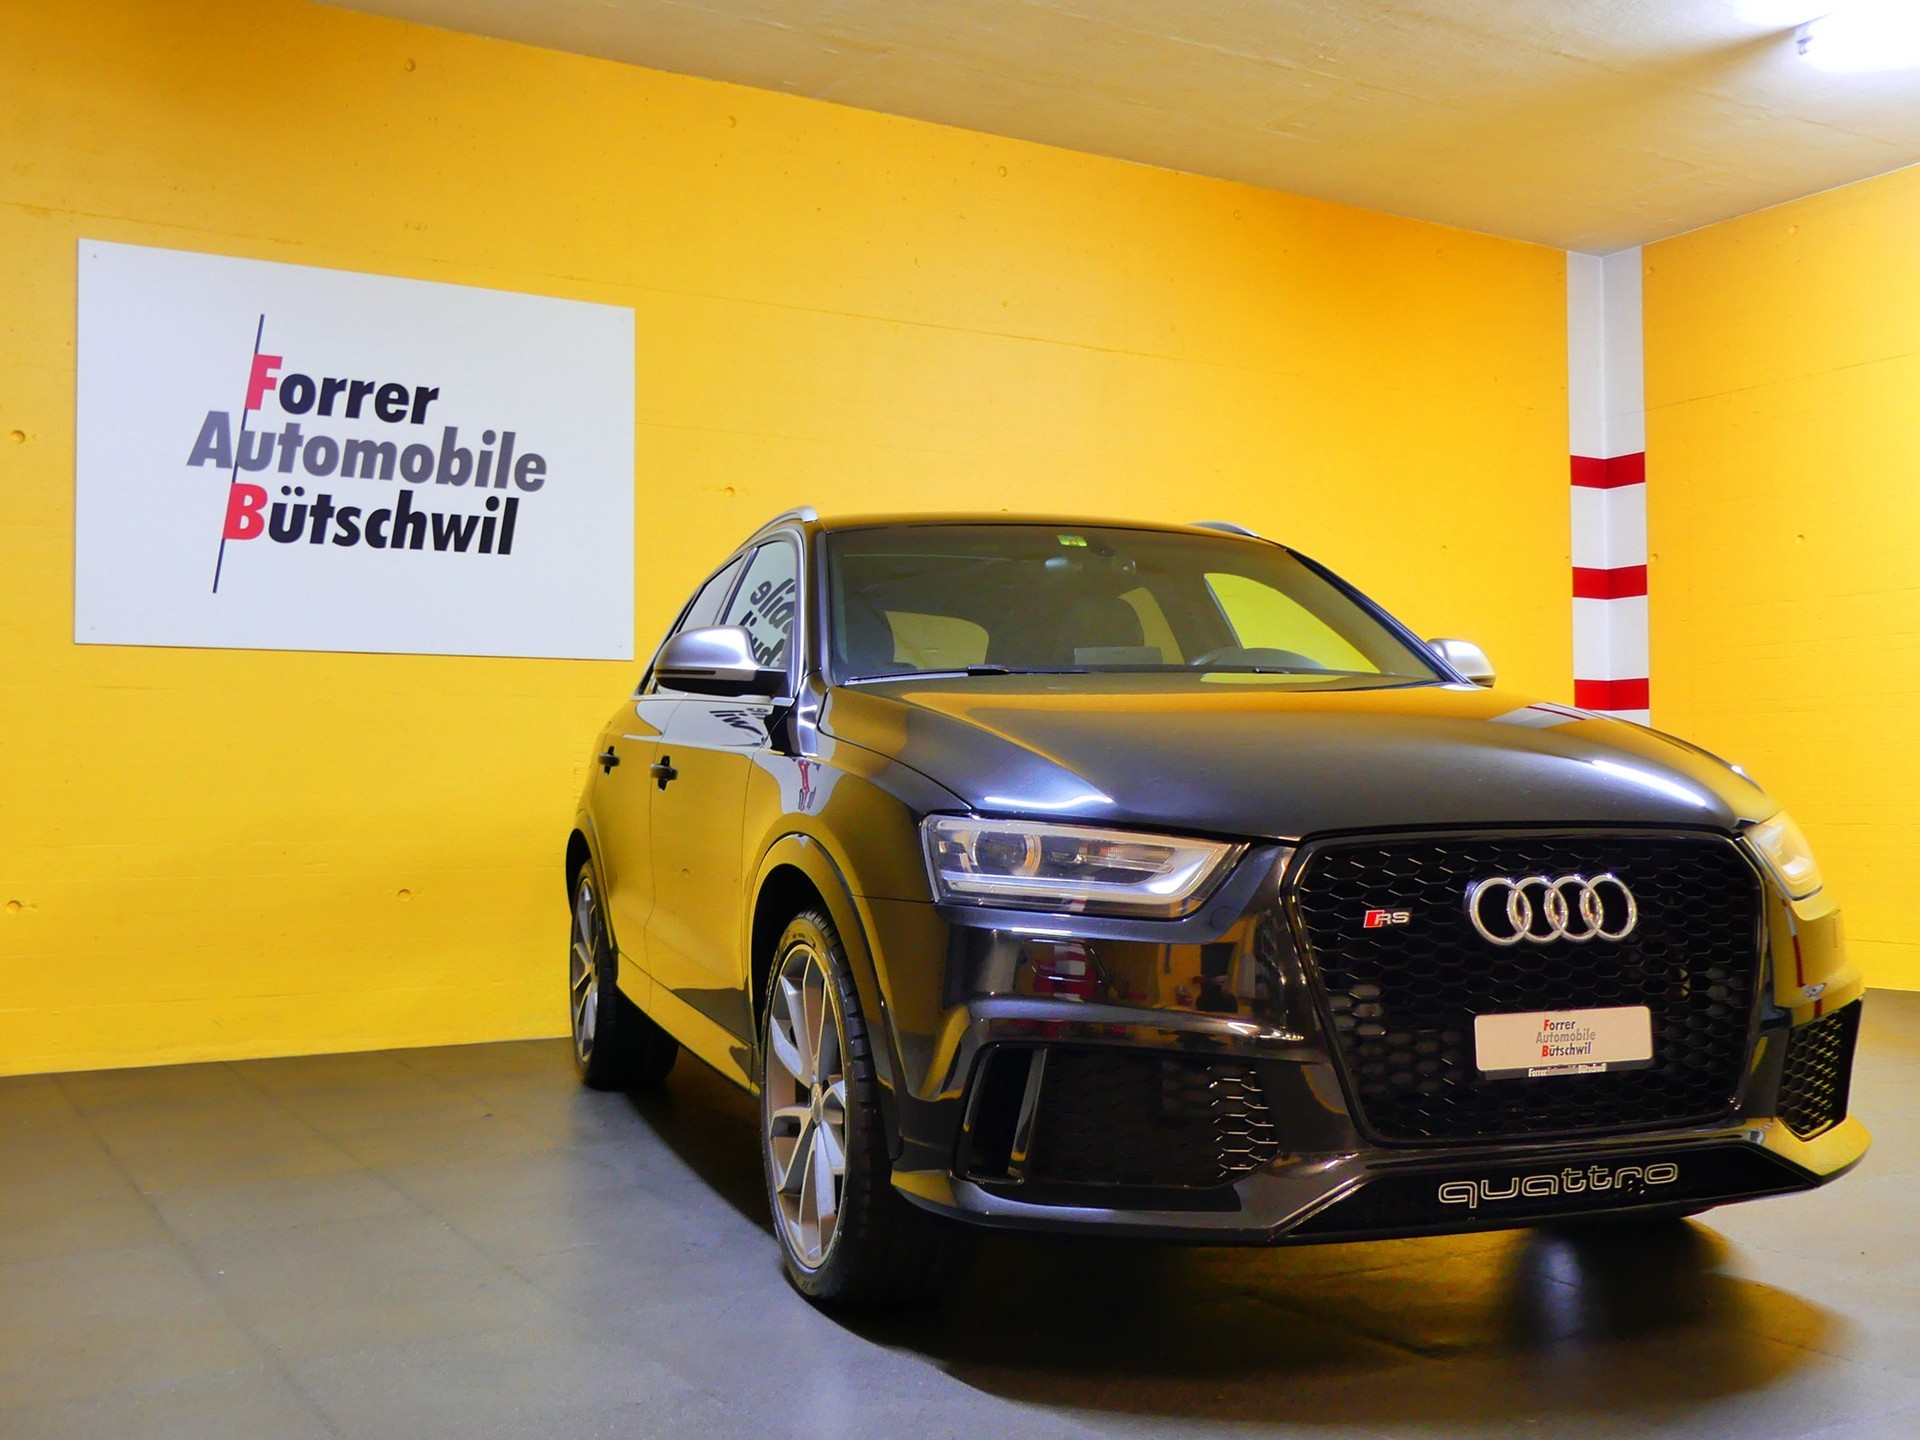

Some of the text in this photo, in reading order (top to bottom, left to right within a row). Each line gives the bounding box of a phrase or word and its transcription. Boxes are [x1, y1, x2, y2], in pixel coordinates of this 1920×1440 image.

[245, 354, 439, 425] Forrer
[186, 410, 548, 492] Automobile
[223, 482, 520, 556] Bütschwil
[1373, 911, 1410, 925] RS
[1536, 1028, 1596, 1044] Automobile
[1543, 1019, 1576, 1031] Forrer
[1542, 1042, 1591, 1057] Bütschwil
[1438, 1162, 1678, 1209] quattro
